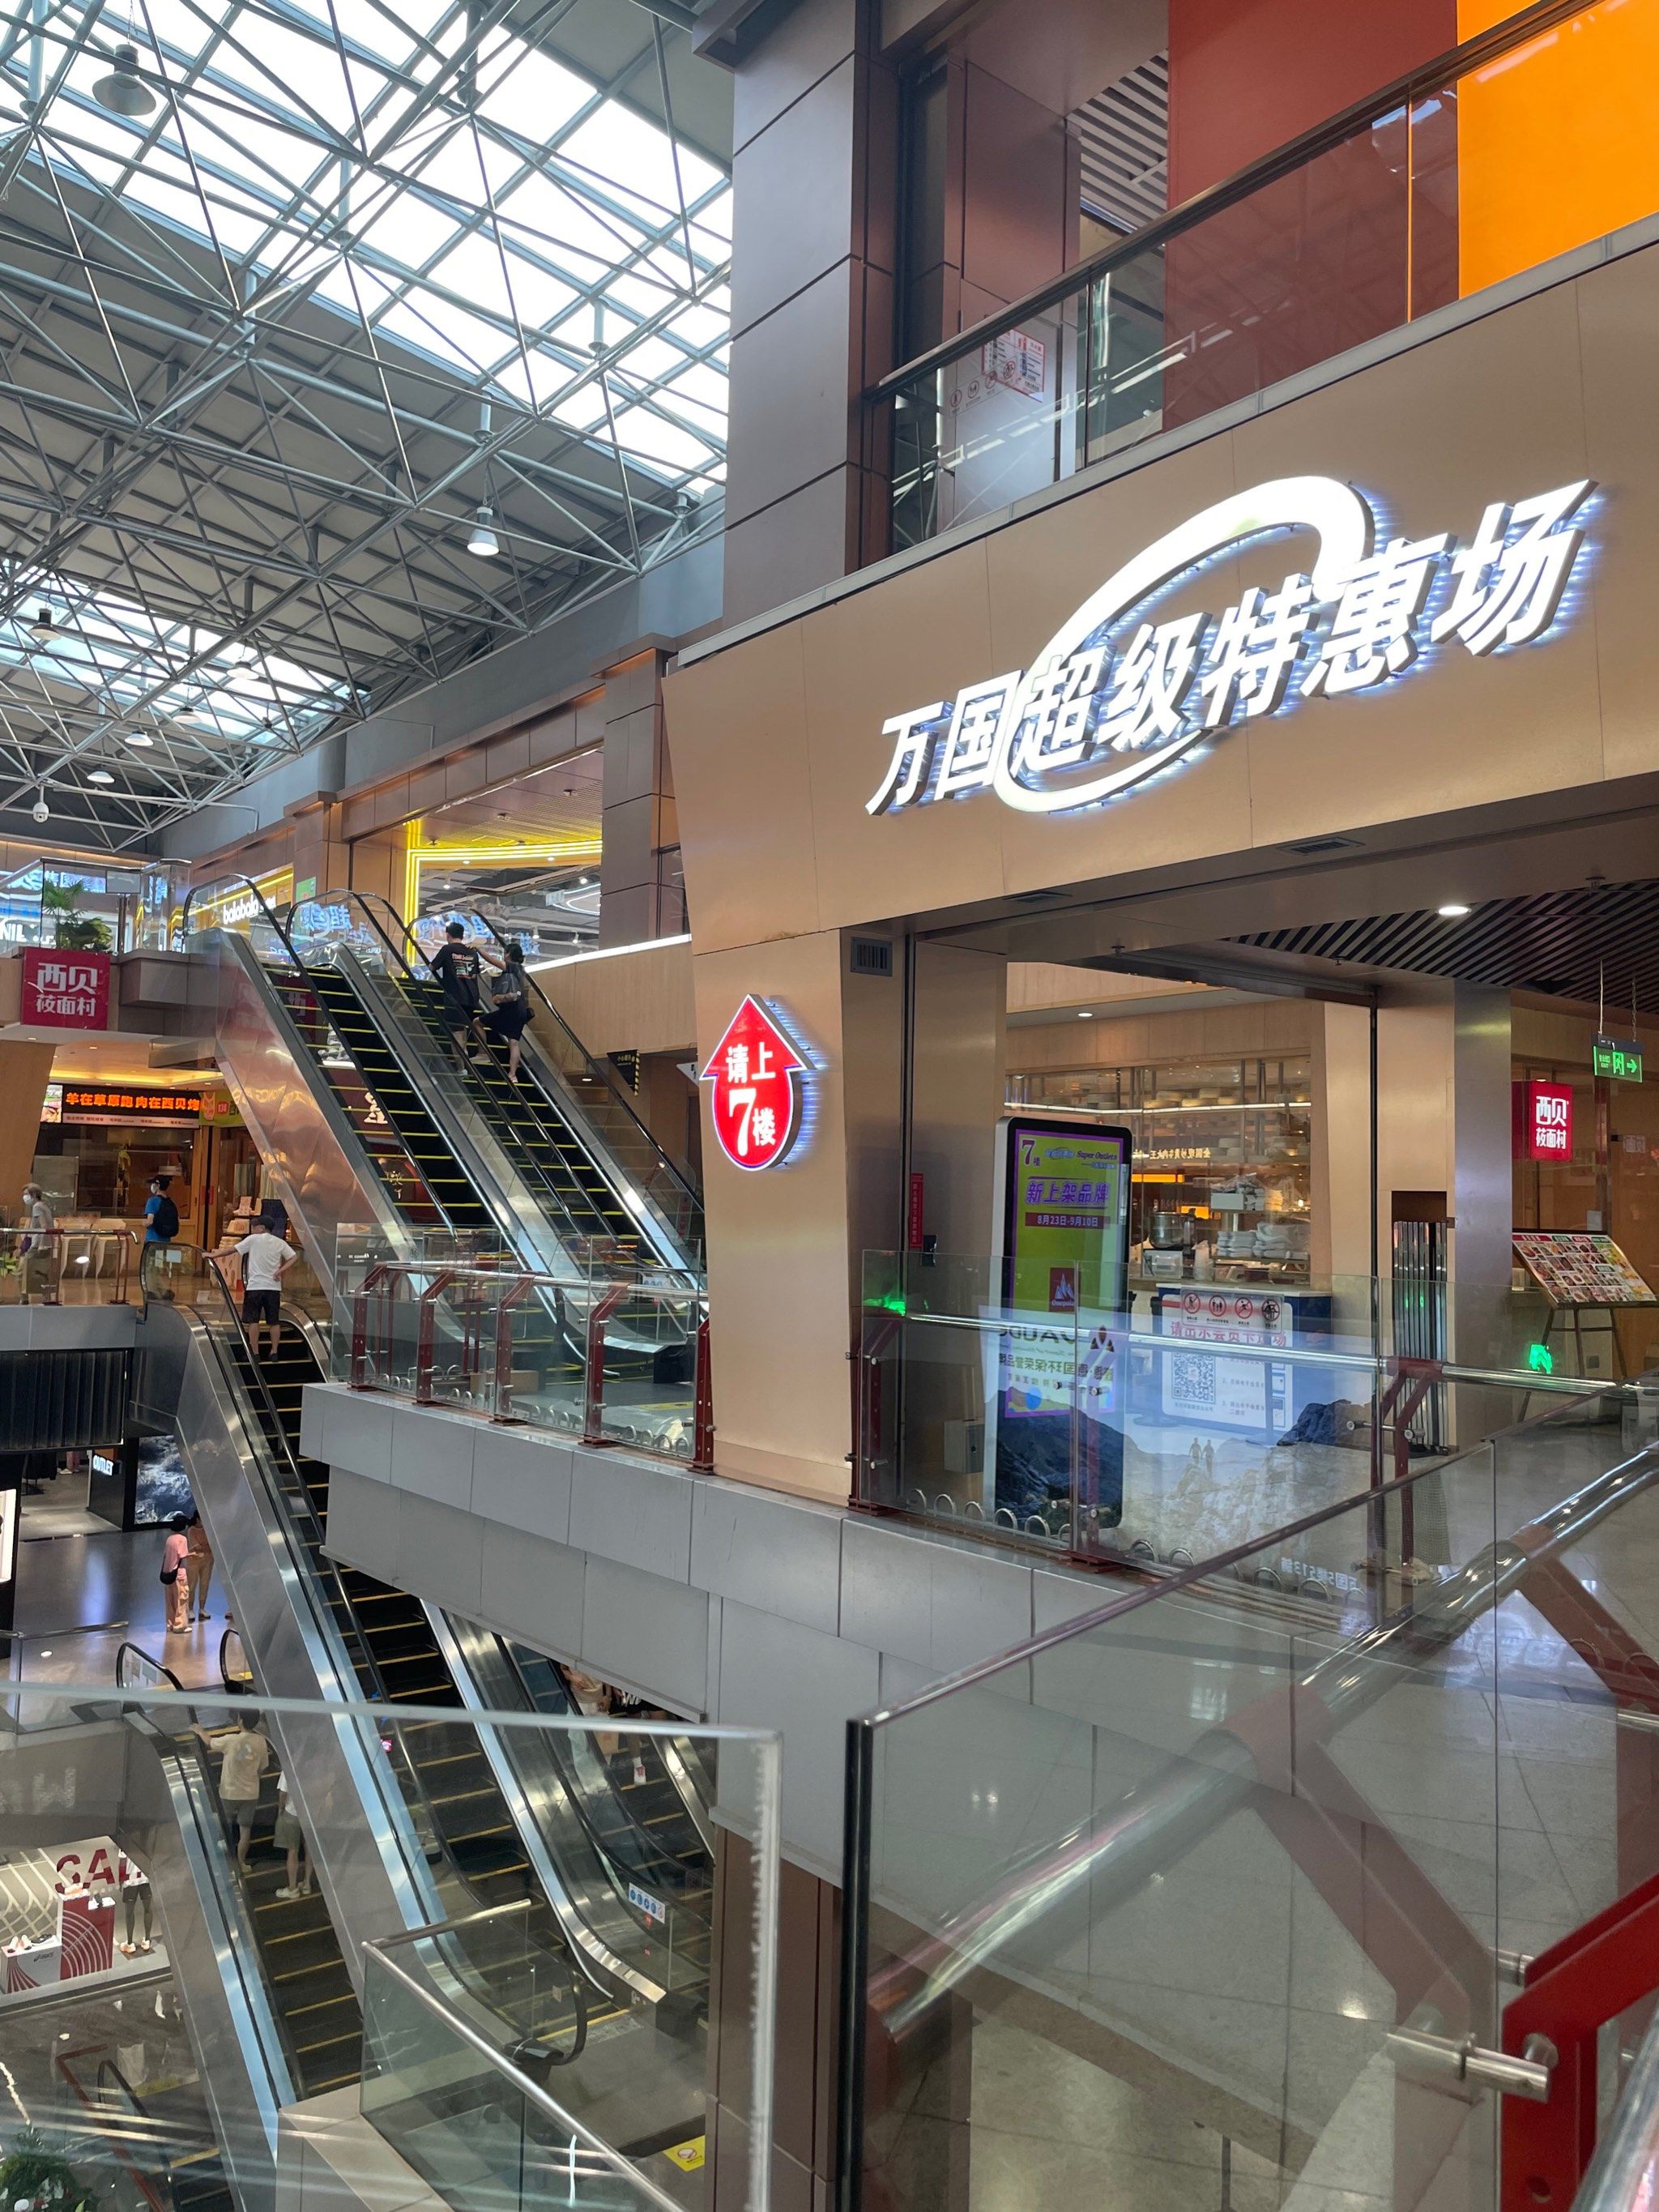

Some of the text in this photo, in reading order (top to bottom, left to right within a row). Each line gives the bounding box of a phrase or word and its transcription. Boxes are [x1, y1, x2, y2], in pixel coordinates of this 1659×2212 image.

[864, 479, 1598, 815] 万国超级特惠场
[37, 963, 97, 995] 西贝
[36, 994, 96, 1017] 莜面村
[726, 1042, 776, 1083] 请上
[729, 1088, 776, 1156] 7楼
[1536, 1095, 1567, 1127] 西贝
[1536, 1127, 1567, 1149] 莜面村
[1026, 1181, 1110, 1204] 新上架品牌
[1037, 1215, 1098, 1227] 8月23日-9月10日
[92, 1454, 114, 1476] OUTLET
[55, 1848, 142, 1894] SAL
